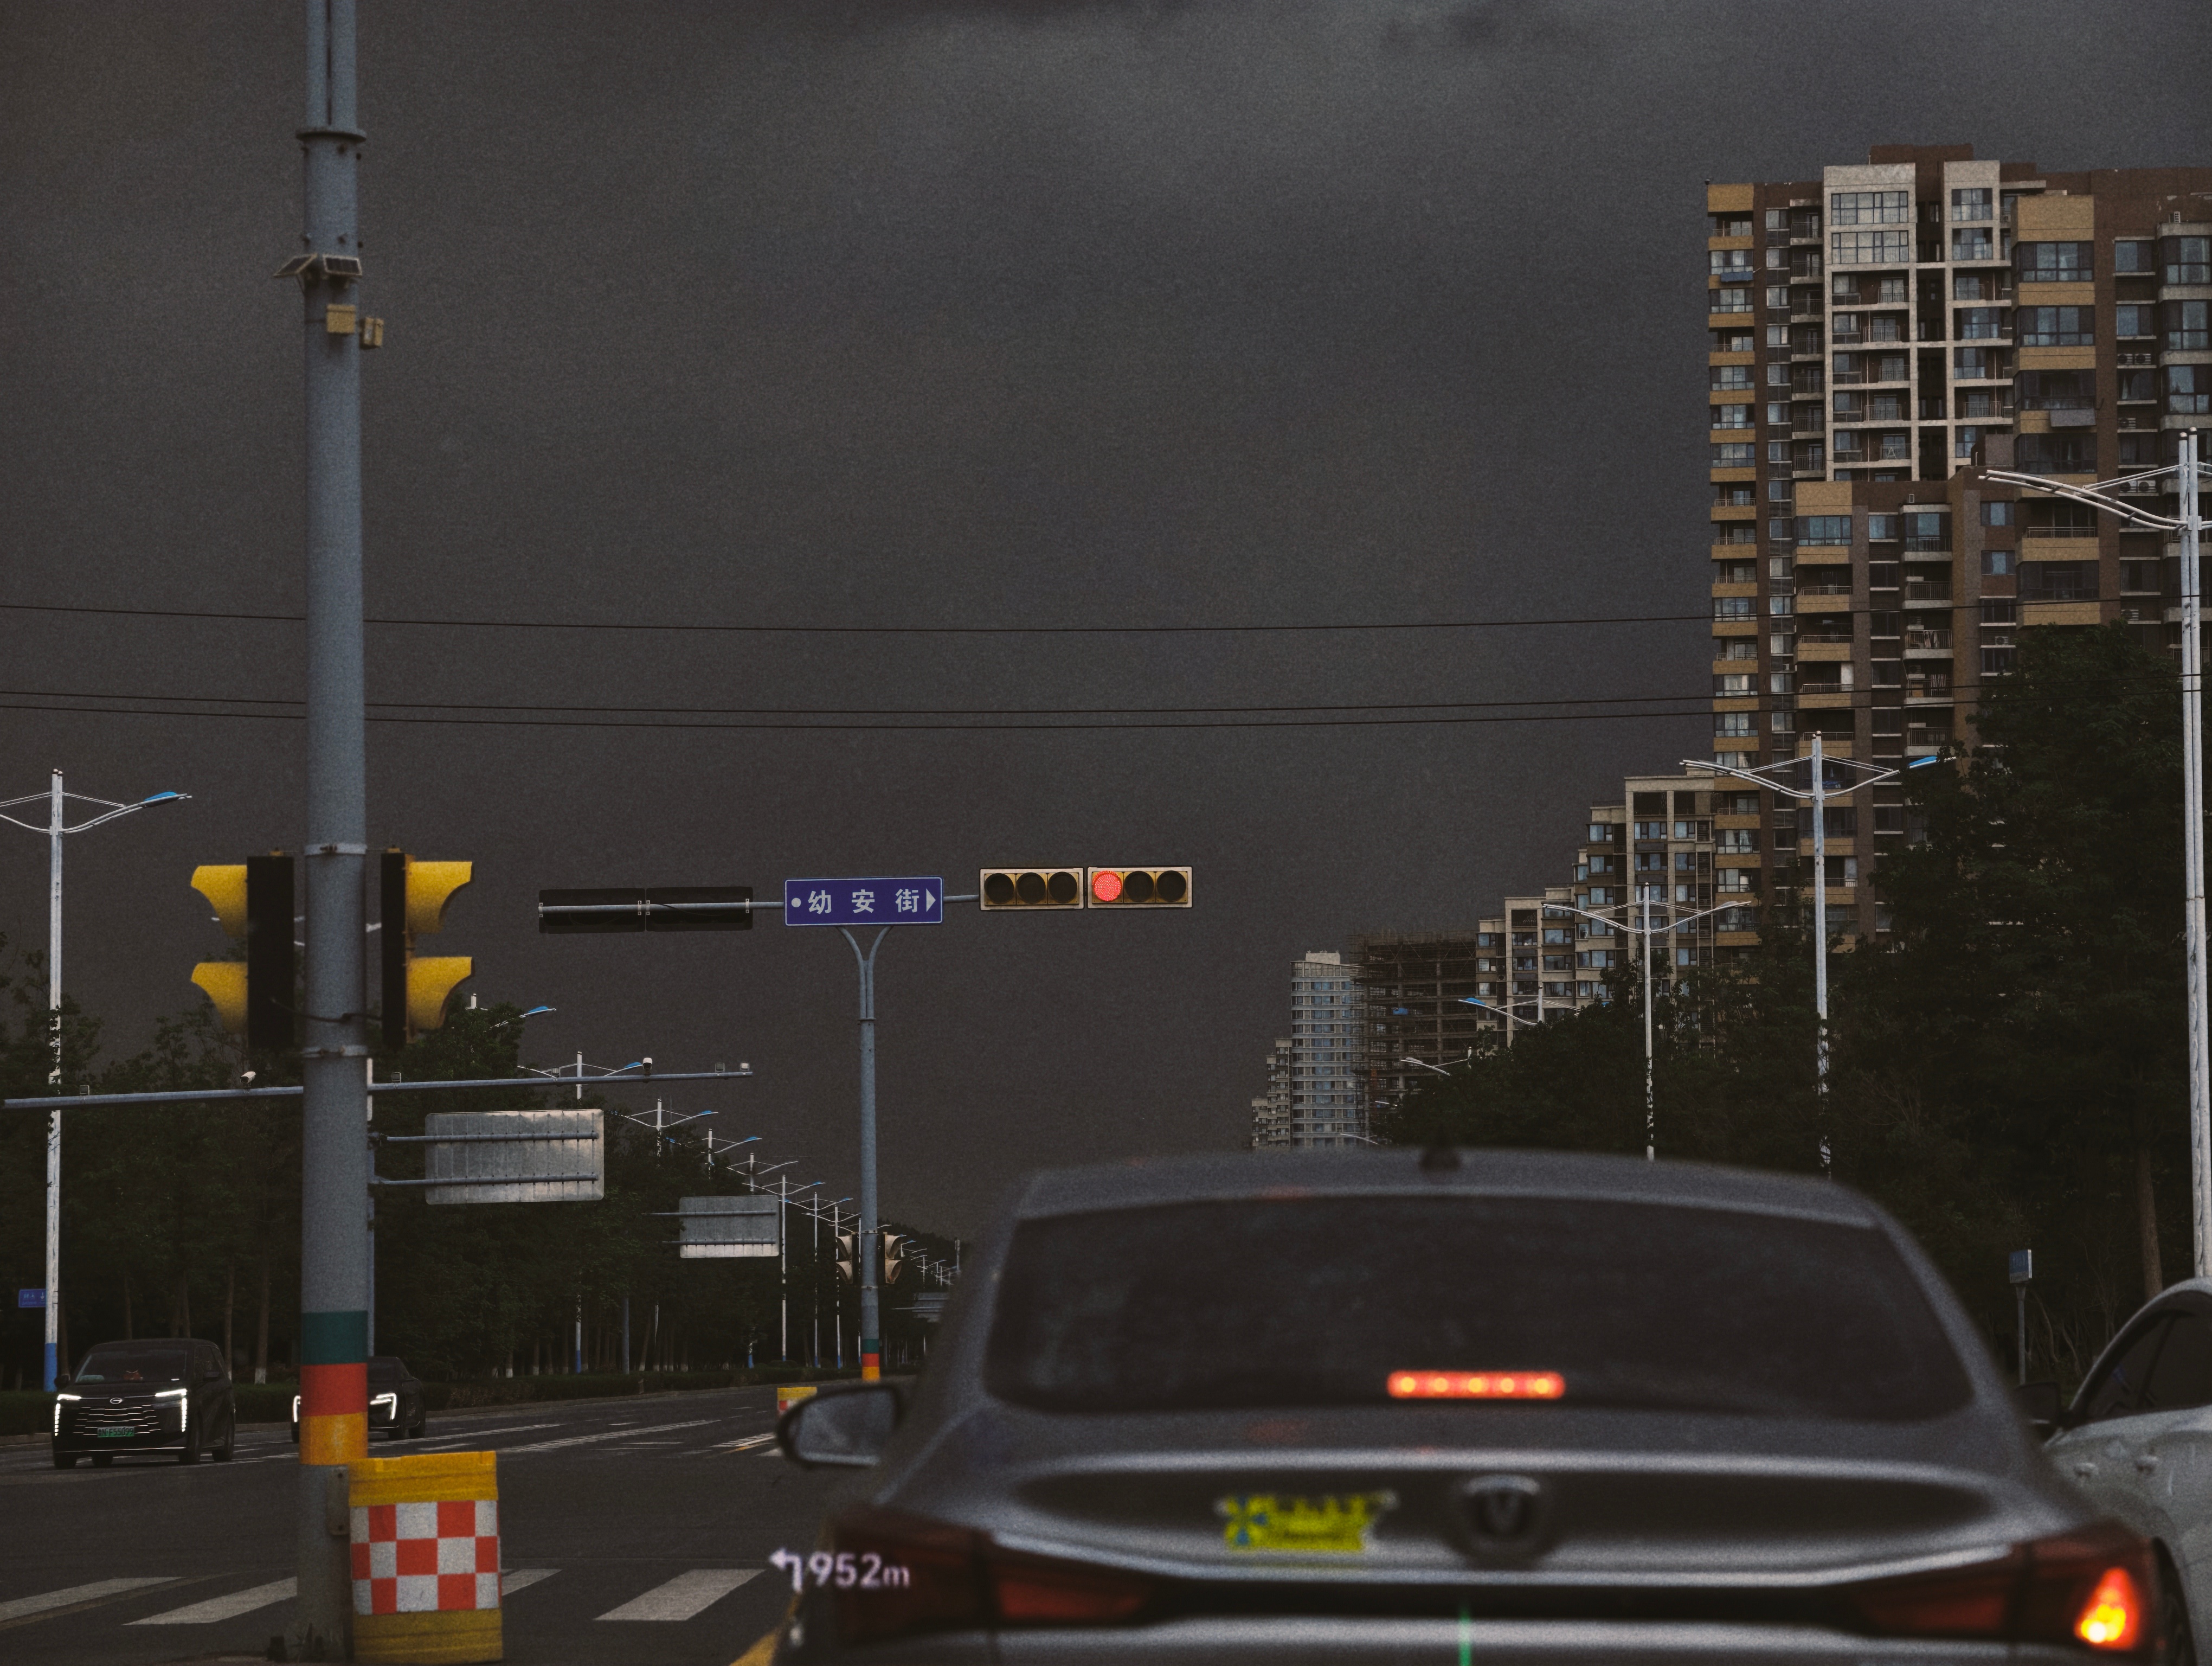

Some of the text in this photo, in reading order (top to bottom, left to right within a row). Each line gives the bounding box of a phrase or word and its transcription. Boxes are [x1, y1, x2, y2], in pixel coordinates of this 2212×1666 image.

[808, 888, 919, 914] 幼安街
[809, 1550, 910, 1588] 952m
